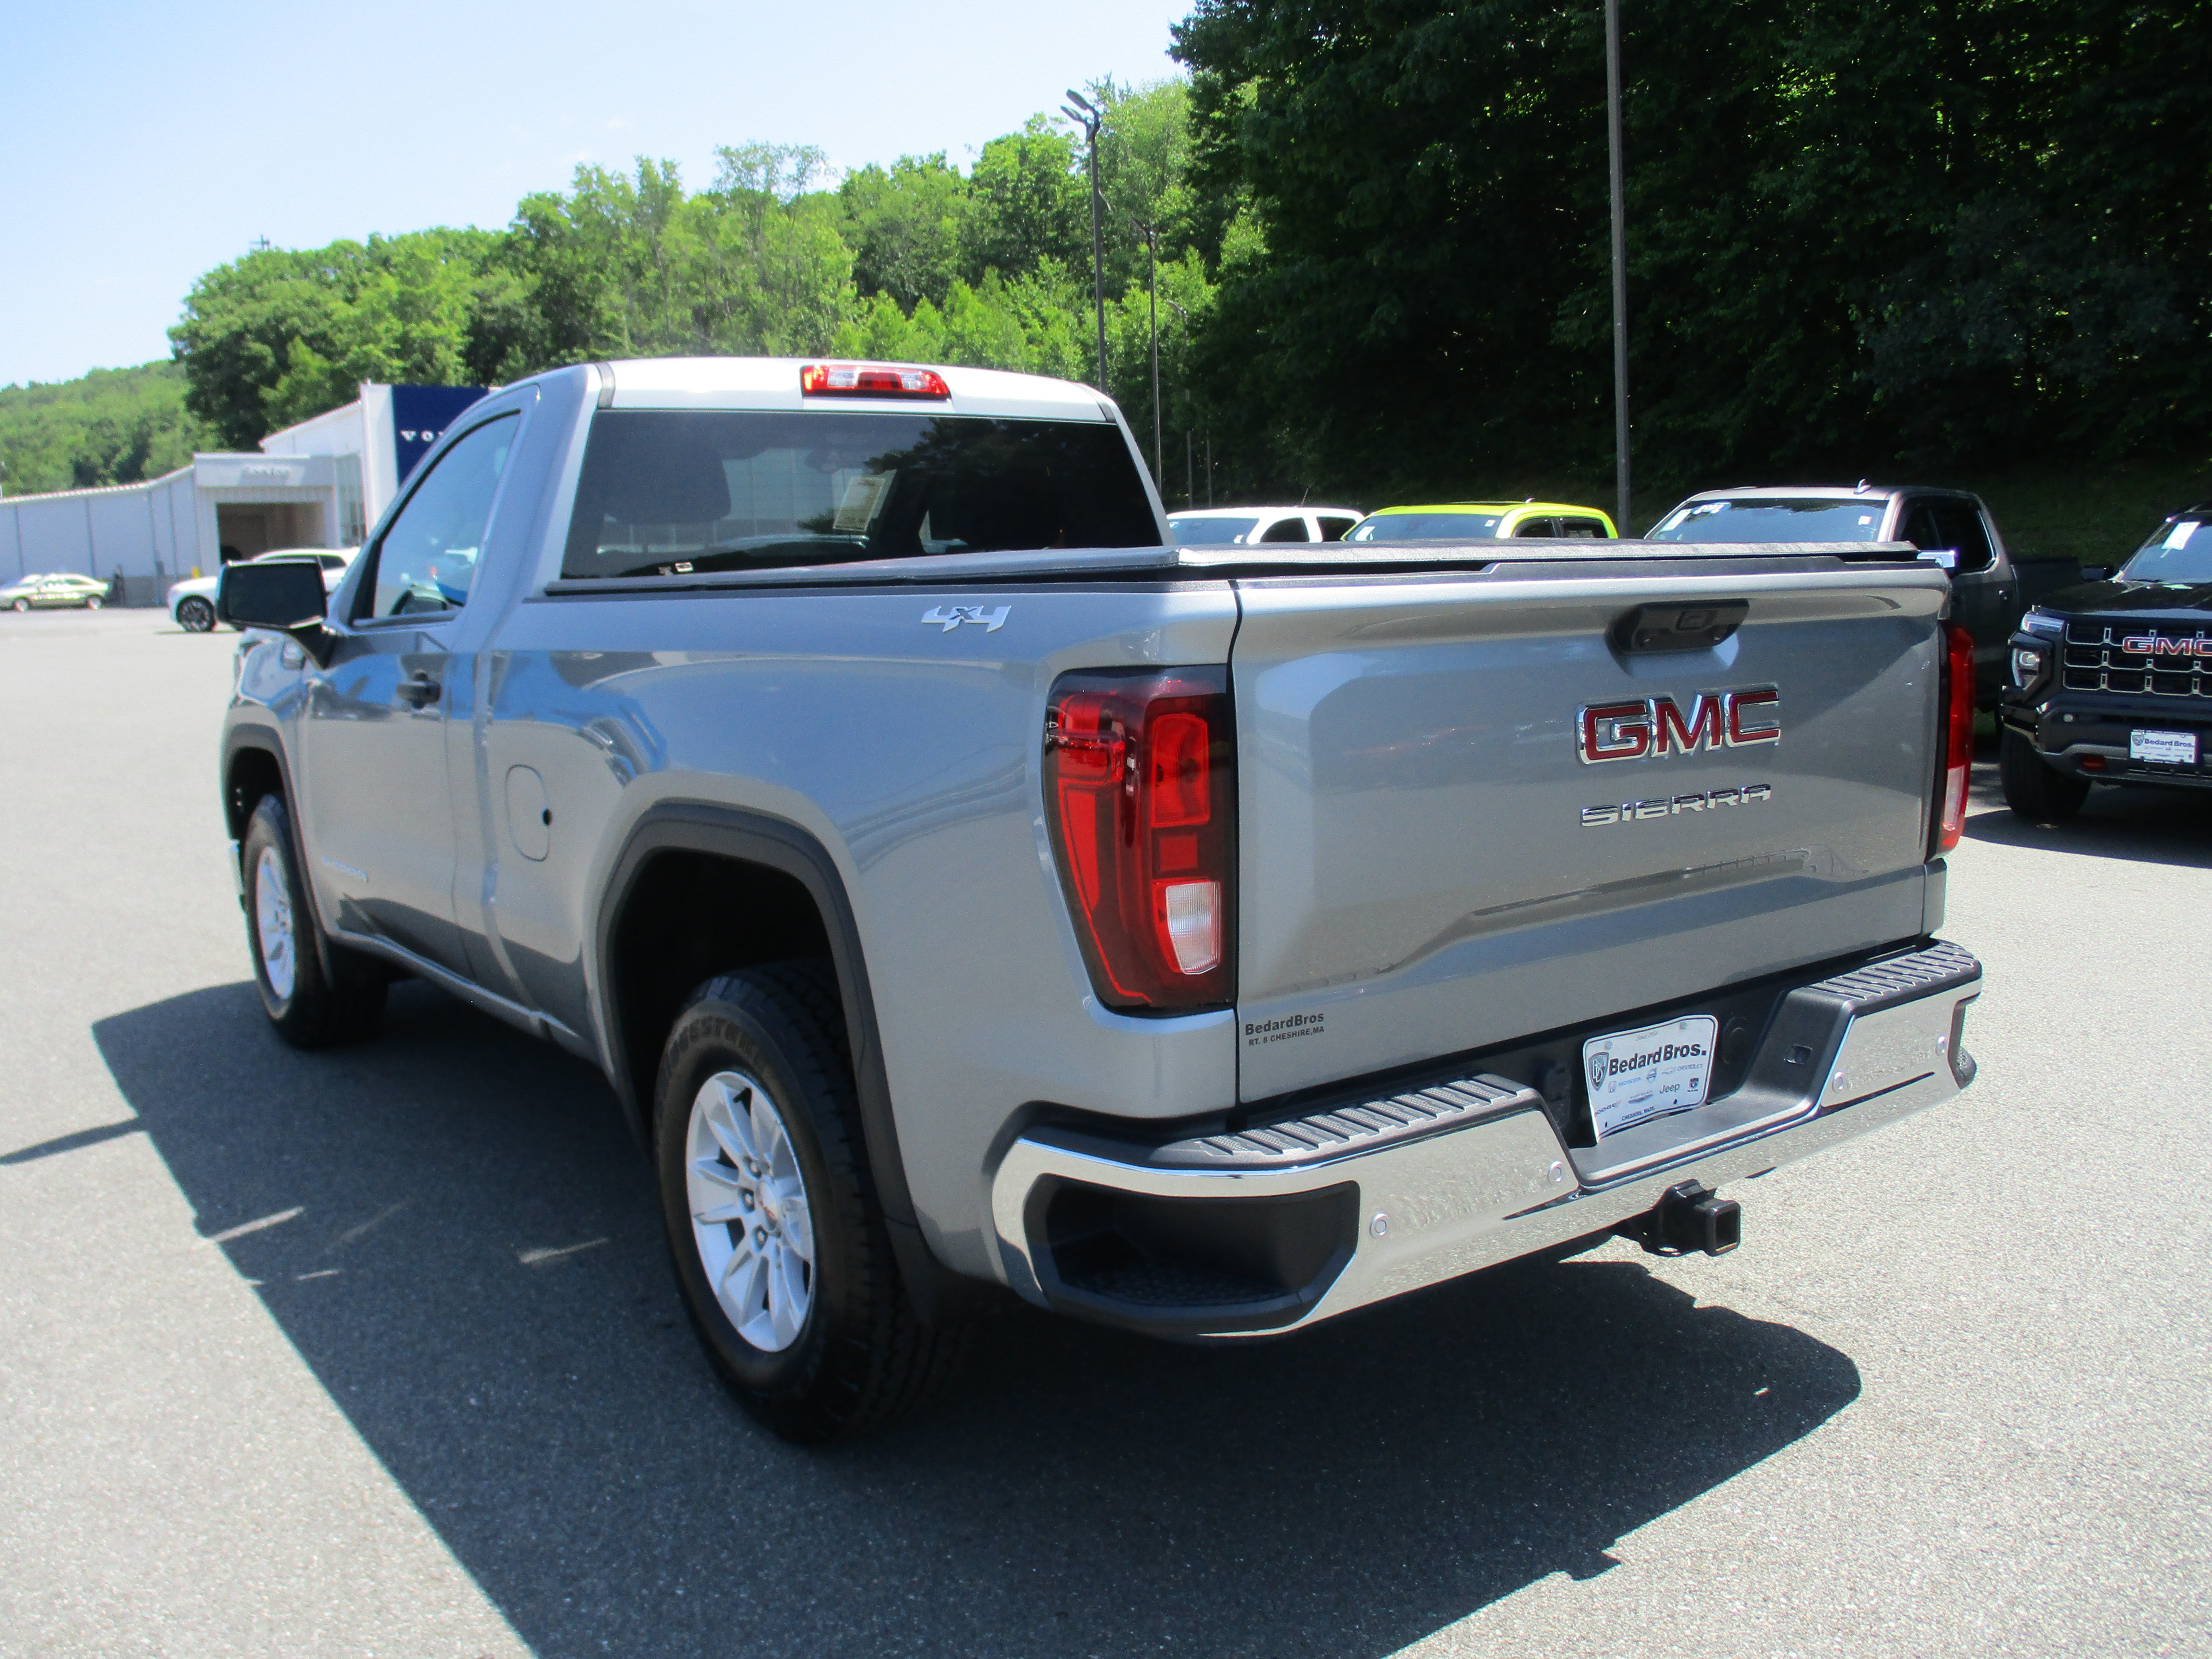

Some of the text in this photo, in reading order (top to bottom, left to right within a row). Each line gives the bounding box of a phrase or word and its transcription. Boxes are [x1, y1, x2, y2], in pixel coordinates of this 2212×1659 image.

[2122, 636, 2212, 656] GMC
[1577, 689, 1781, 765] GMC
[1581, 784, 1771, 827] SIERRA
[1249, 1038, 1261, 1046] RT.
[1609, 1043, 1707, 1076] Bedard Bros.
[1659, 1082, 1680, 1094] Jeep
